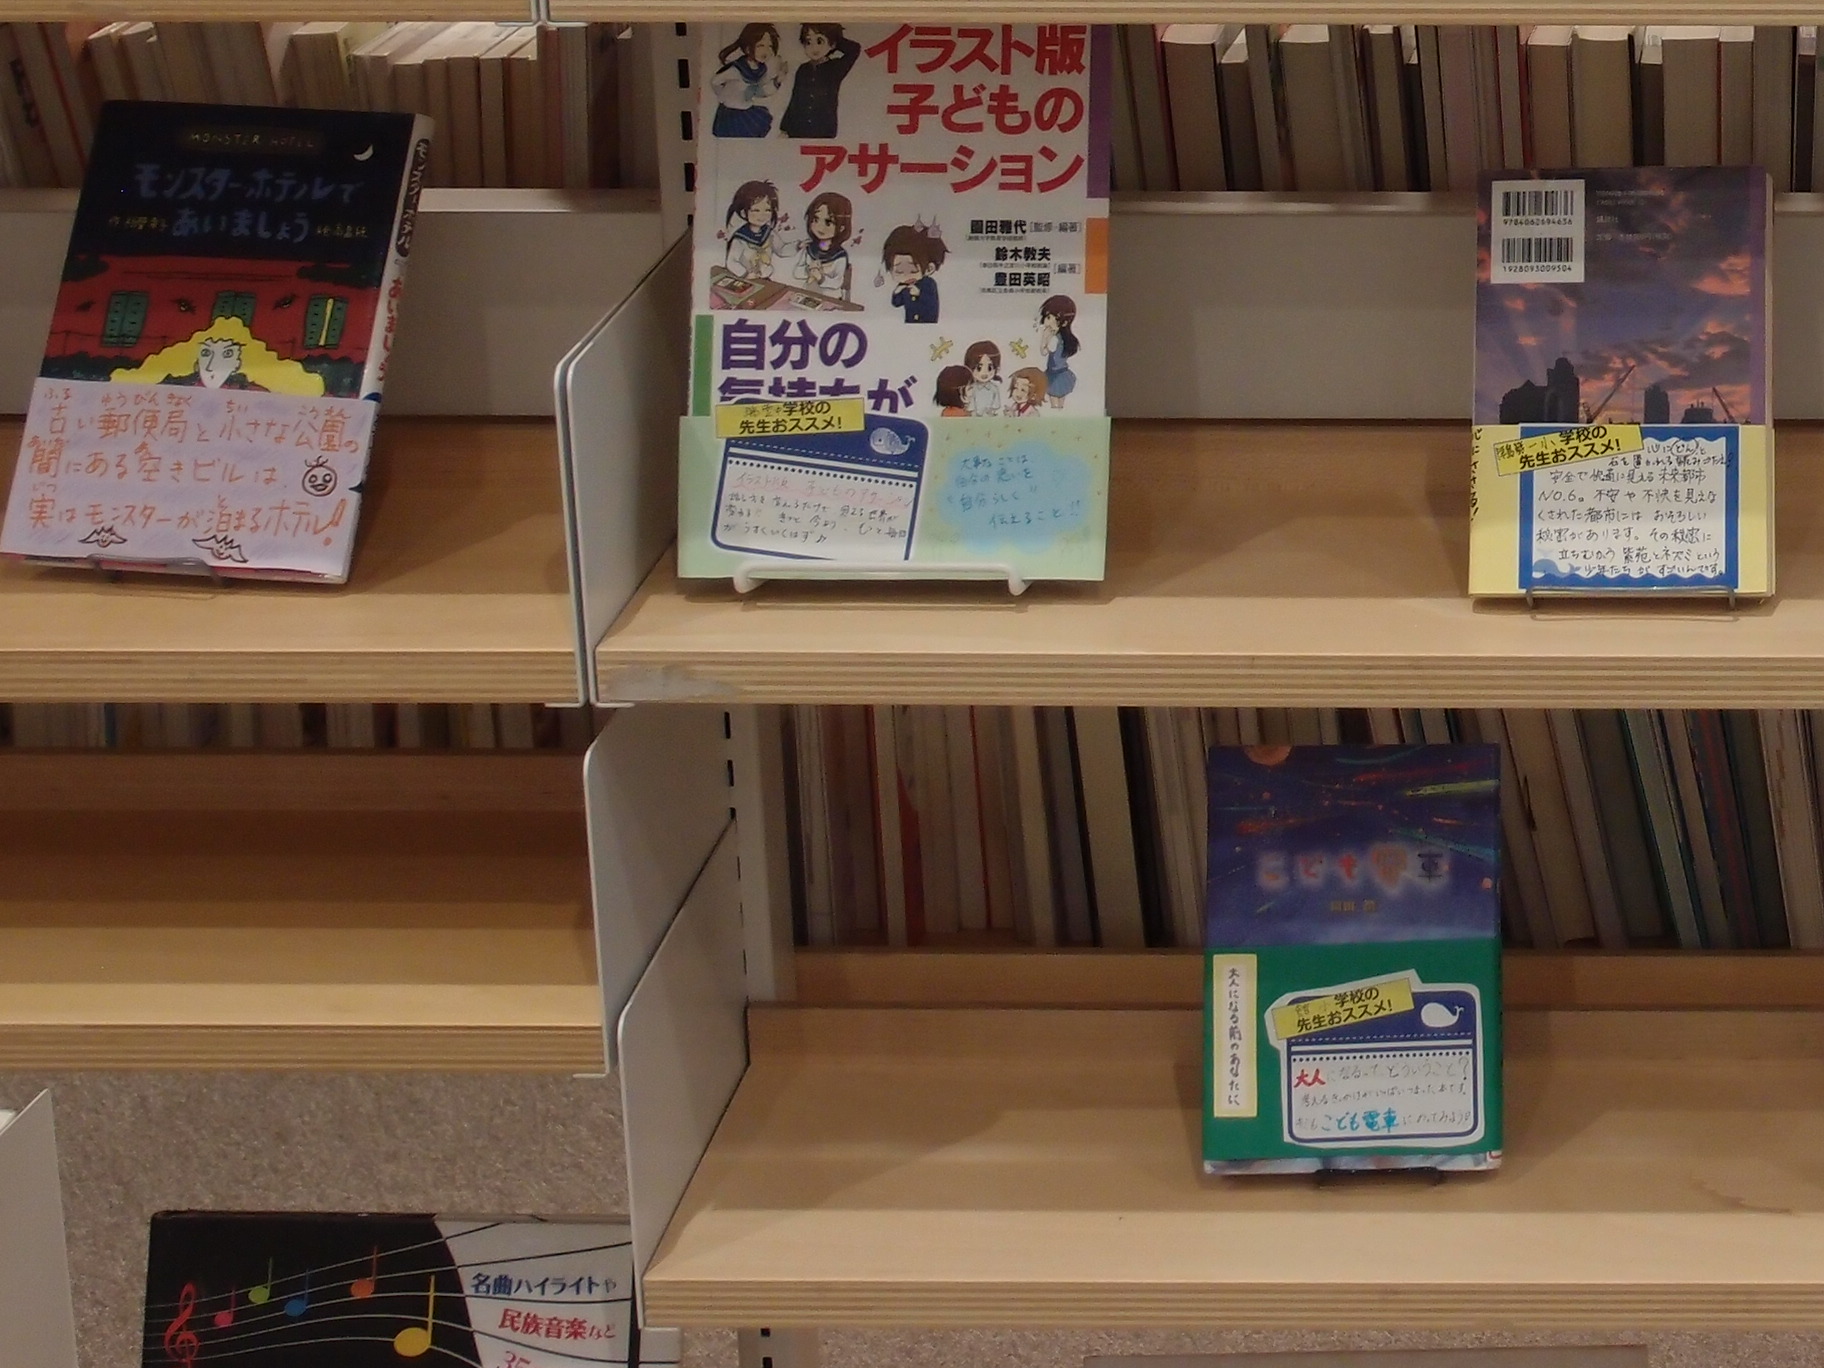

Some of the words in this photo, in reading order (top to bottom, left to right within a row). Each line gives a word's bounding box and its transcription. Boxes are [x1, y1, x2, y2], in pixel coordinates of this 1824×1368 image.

[864, 24, 1087, 76] イラスト版
[887, 83, 1085, 135] 子どもの
[799, 143, 1084, 194] アサーション
[721, 318, 868, 372] 自分の
[784, 401, 830, 416] 学校の
[740, 416, 842, 434] 先生おススメ!
[1559, 426, 1607, 445] 学校の
[1519, 438, 1622, 469] 先生おススメ!
[1334, 987, 1379, 1008] 学校の
[1296, 1000, 1394, 1033] 先生おススメ!
[471, 1273, 617, 1296] 名曲ハイライトや
[499, 1309, 616, 1340] 民族音楽など
